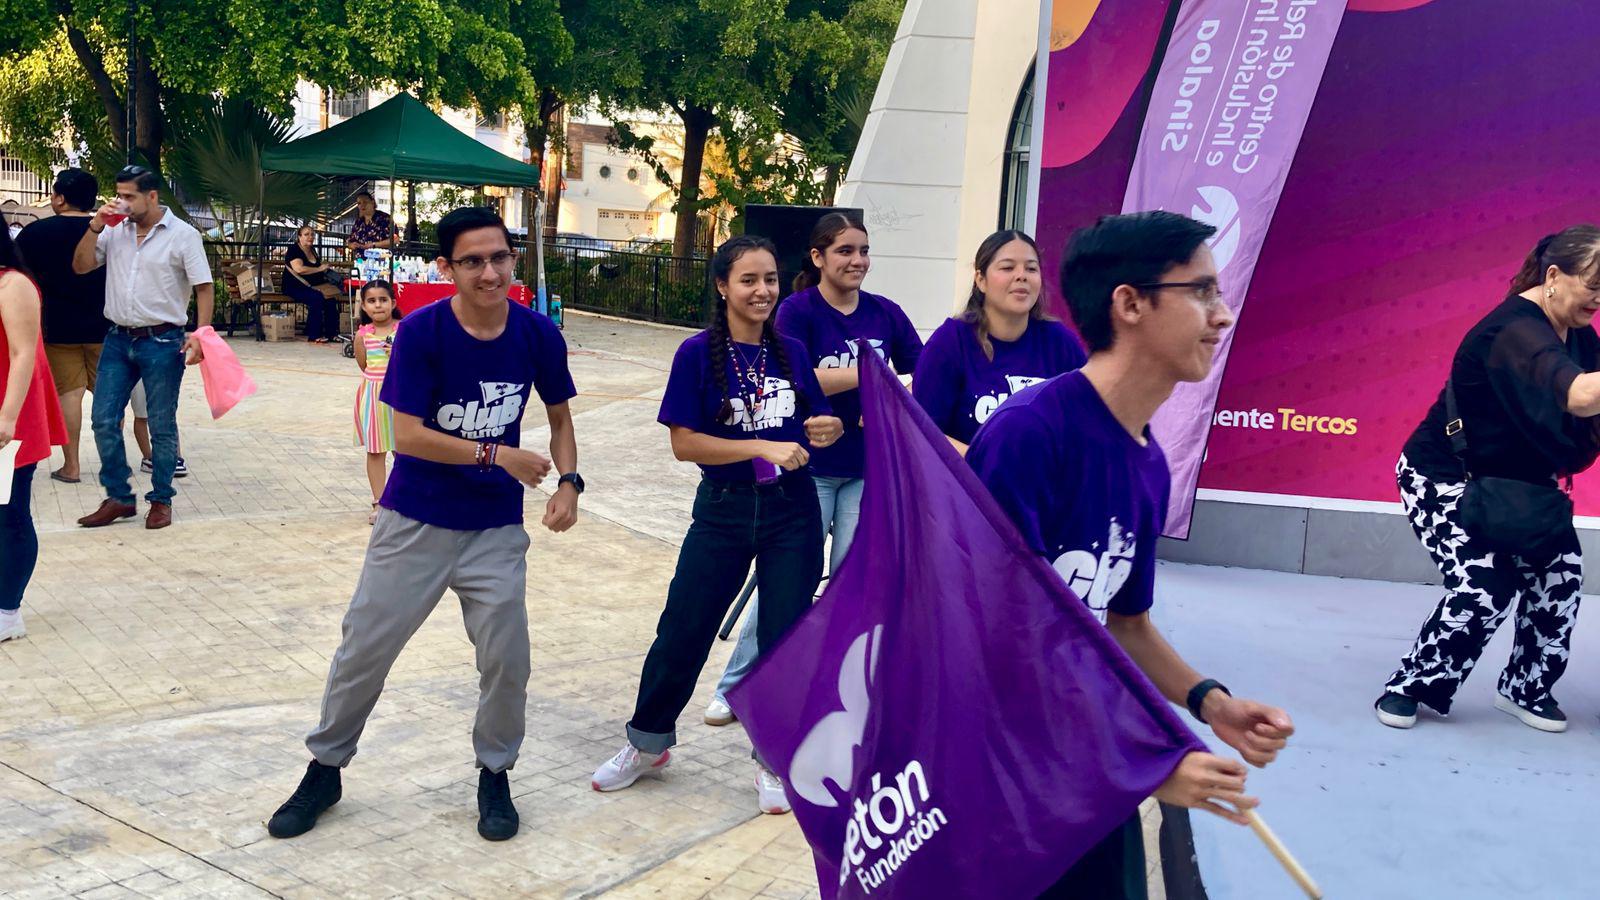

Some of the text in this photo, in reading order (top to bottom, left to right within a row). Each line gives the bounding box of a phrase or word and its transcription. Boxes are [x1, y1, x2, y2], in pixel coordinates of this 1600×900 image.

[1277, 408, 1358, 435] Tercos
[840, 760, 930, 887] etón
[855, 807, 948, 895] Fundación
